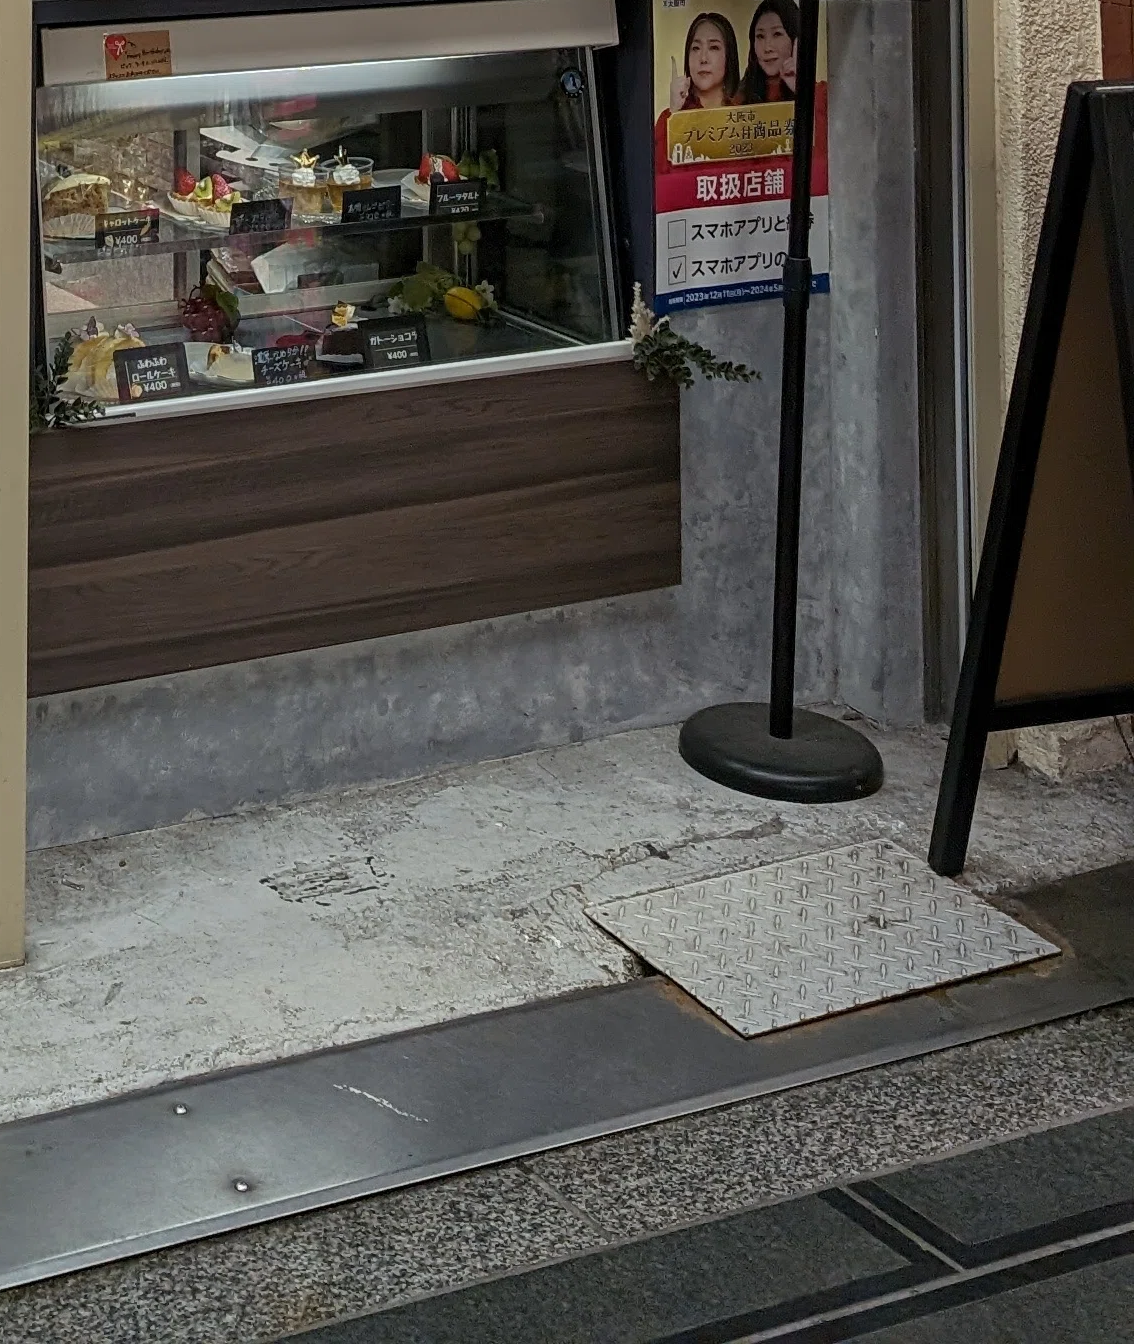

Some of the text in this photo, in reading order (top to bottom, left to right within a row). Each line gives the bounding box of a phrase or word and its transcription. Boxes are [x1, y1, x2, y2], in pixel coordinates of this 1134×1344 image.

[696, 167, 785, 202] 取扱店舗
[115, 235, 138, 245] ¥400
[691, 251, 789, 278] スマホアプリの
[387, 350, 407, 359] ¥400
[137, 357, 167, 370] ふわふわ
[132, 369, 176, 382] ロールケーキ
[144, 380, 168, 392] ¥400
